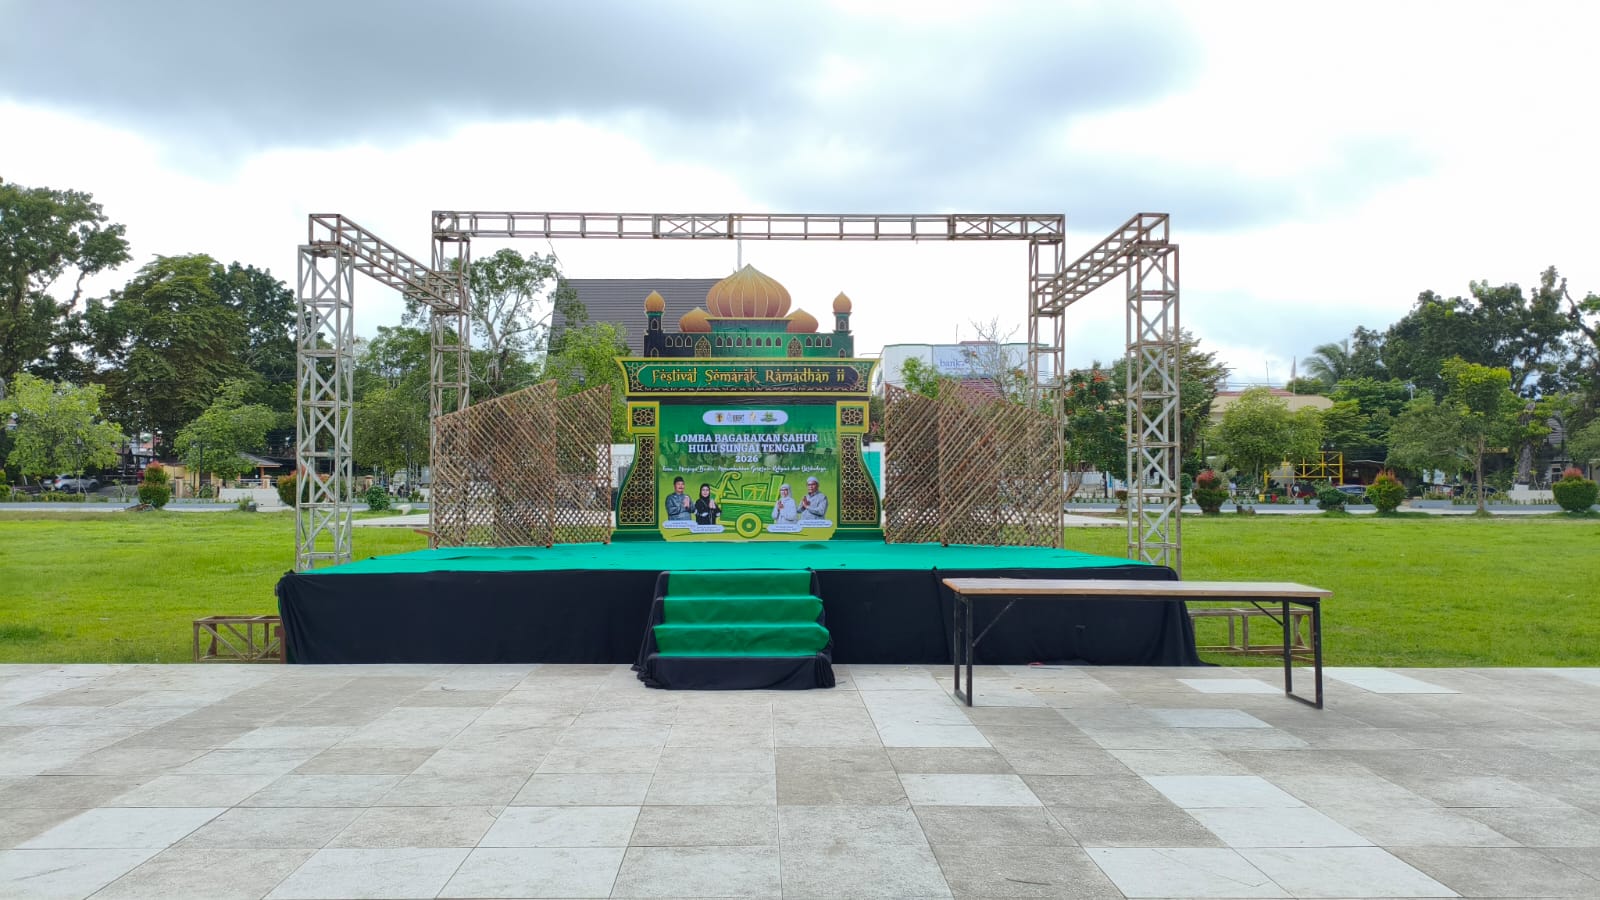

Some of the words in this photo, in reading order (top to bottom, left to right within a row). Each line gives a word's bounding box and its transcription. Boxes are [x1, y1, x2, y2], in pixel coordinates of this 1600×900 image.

[652, 367, 697, 384] Festival
[704, 367, 760, 384] Semarak
[765, 367, 830, 383] Ramadhan
[674, 433, 713, 443] LOMBA
[714, 433, 780, 443] BAGARAKAN
[782, 433, 819, 443] SAHUR
[688, 443, 718, 453] HULU
[719, 443, 760, 453] SUNGAI
[761, 443, 805, 453] TENGAH
[735, 454, 759, 463] 2026
